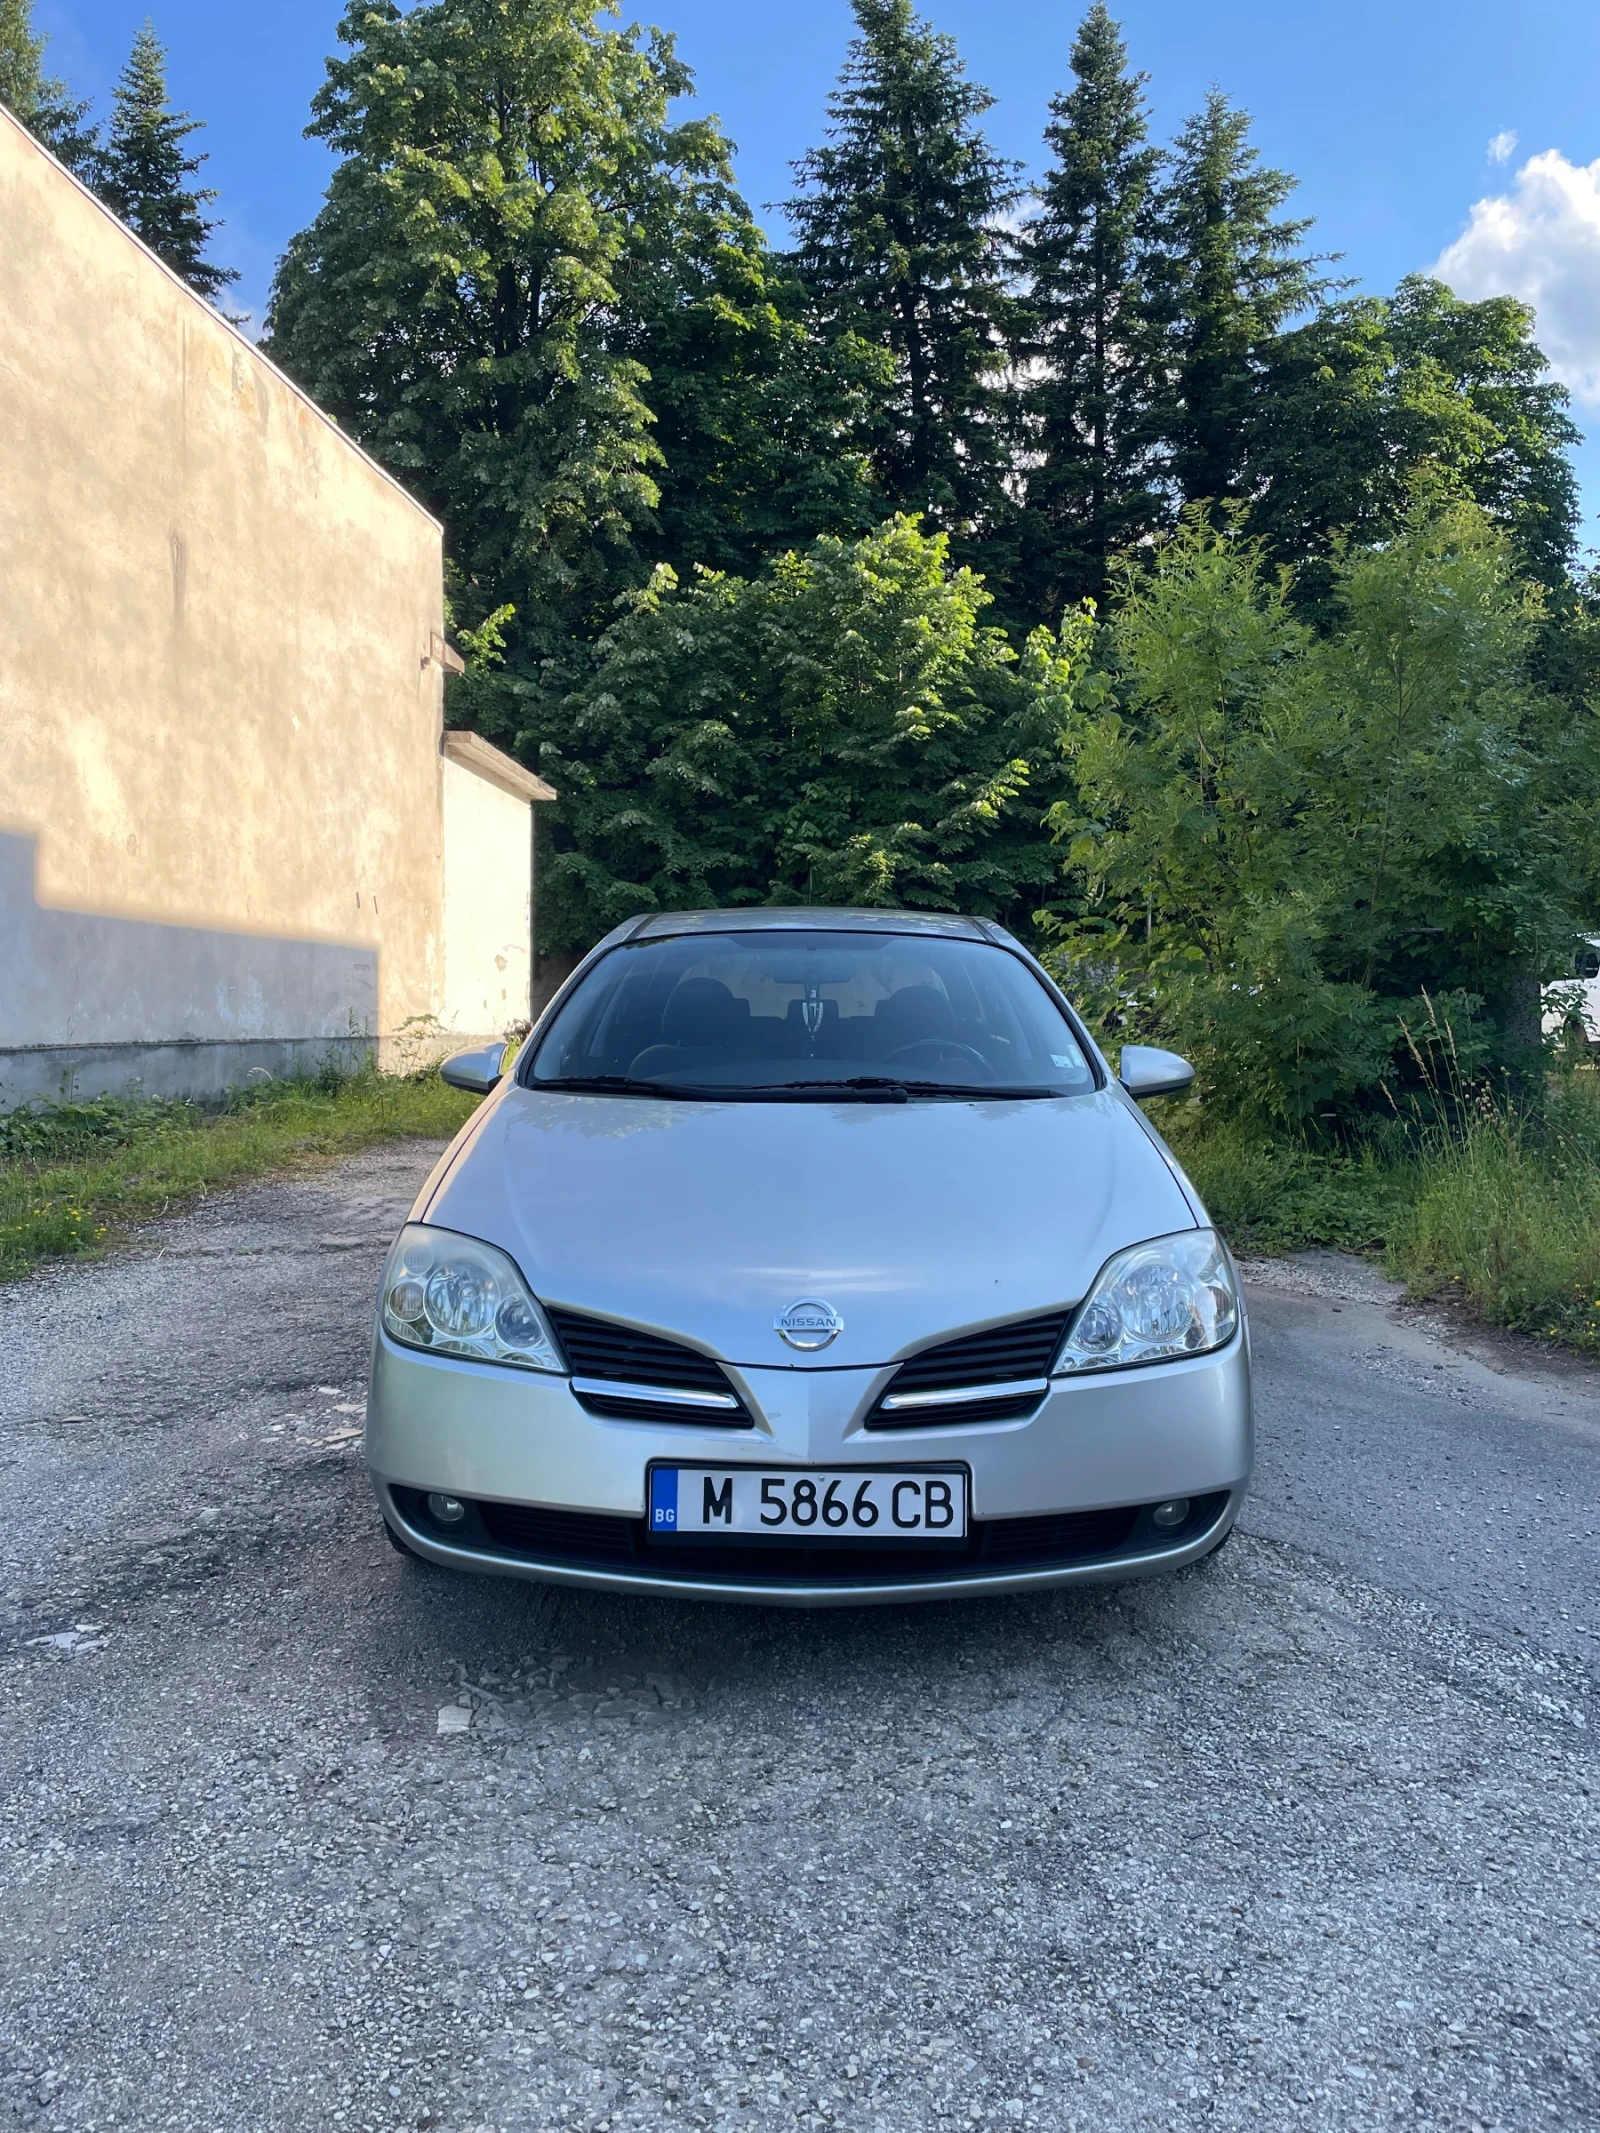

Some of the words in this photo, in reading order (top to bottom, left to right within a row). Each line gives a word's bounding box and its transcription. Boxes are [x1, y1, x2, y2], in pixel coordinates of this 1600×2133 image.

[781, 1317, 837, 1327] NISSAN
[702, 1476, 733, 1525] M
[760, 1478, 879, 1528] 5866
[892, 1480, 954, 1529] CB
[655, 1508, 675, 1523] BG
